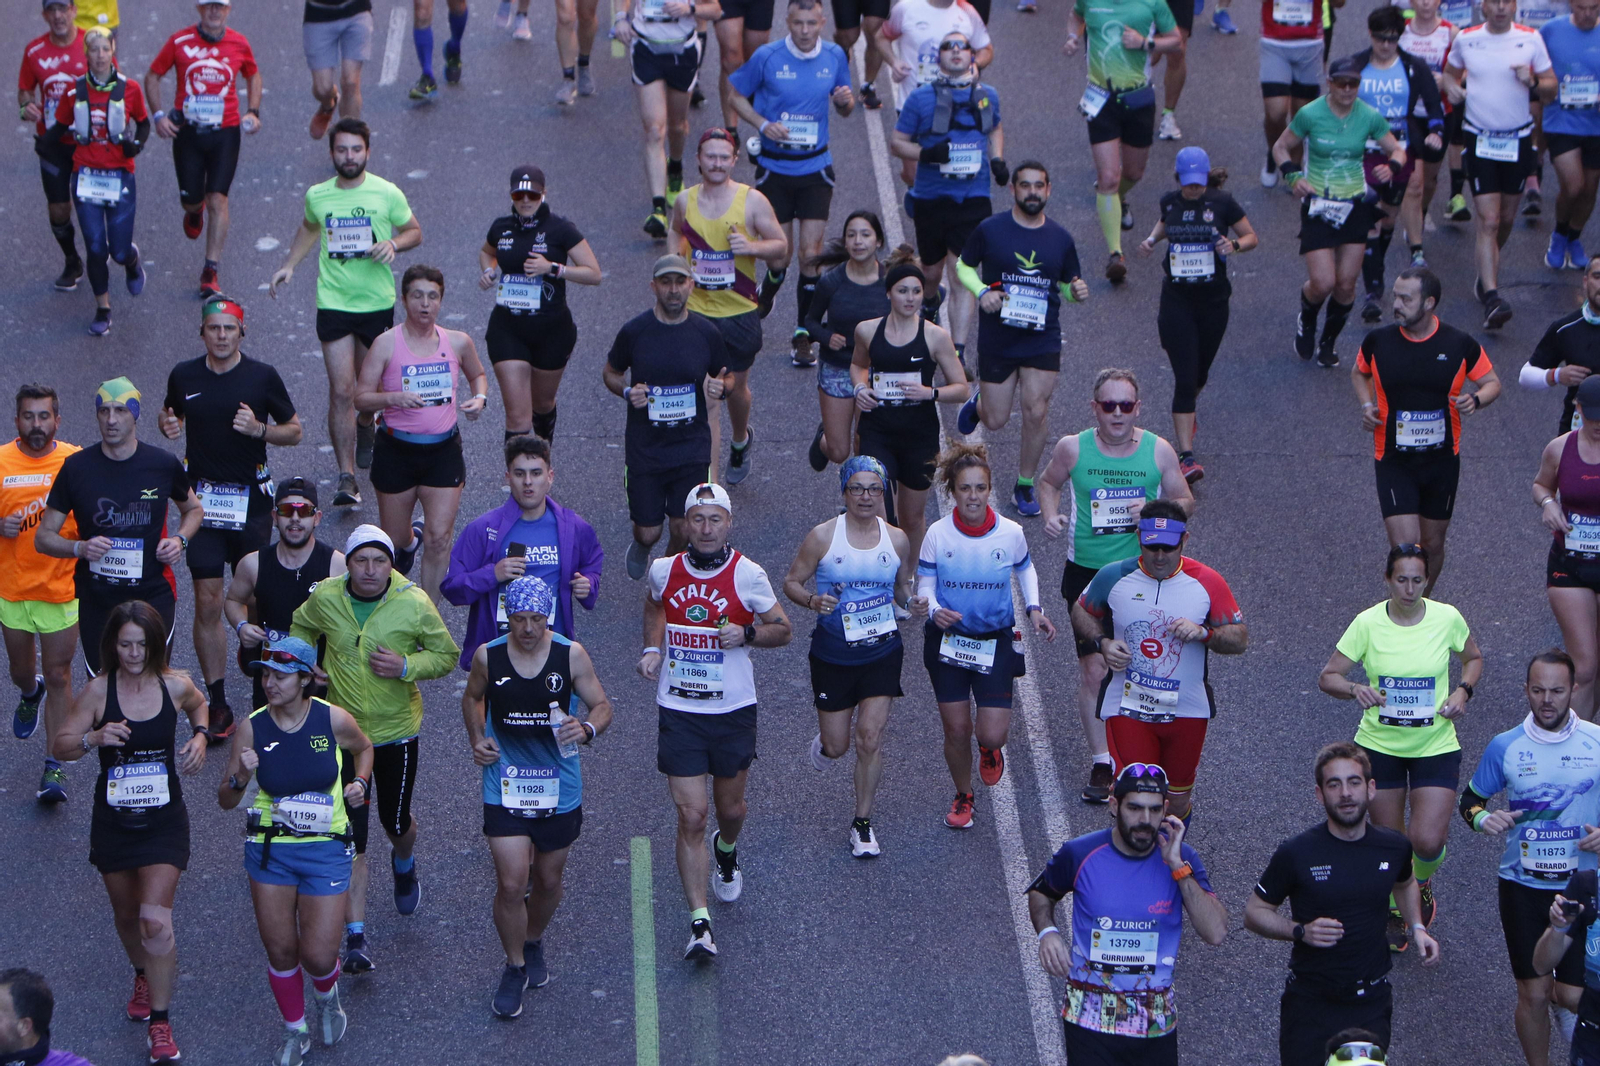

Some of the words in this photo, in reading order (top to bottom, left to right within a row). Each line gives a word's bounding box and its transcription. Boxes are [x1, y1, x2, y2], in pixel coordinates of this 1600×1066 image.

[1363, 78, 1403, 93] TIME
[1374, 94, 1393, 106] TO
[1002, 272, 1051, 285] Extremadura
[1020, 288, 1045, 298] ZURICH
[418, 365, 445, 374] ZURICH
[416, 379, 440, 388] 13059
[664, 387, 690, 395] ZURICH
[1088, 468, 1146, 478] STUBBINGTON
[4, 475, 42, 484] #BEACTIVE
[1109, 489, 1139, 498] ZURICH
[209, 499, 234, 508] 12483
[203, 511, 235, 520] BERNARDO
[104, 556, 126, 566] 9780
[959, 582, 1005, 590] VEREITAS
[669, 583, 729, 612] ITALIA
[858, 596, 886, 610] ZURICH
[858, 613, 882, 625] 13867
[668, 630, 723, 650] ROBERT
[956, 639, 982, 650] 13450
[685, 652, 716, 662] ZURICH
[955, 652, 977, 661] ESTEFA
[681, 668, 708, 677] 11869
[680, 681, 708, 690] ROBERTO
[1141, 677, 1173, 689] ZURICH
[1139, 693, 1160, 704] 9724
[1393, 696, 1419, 704] 13931
[126, 766, 160, 775] ZURICH
[125, 785, 154, 794] 11229
[516, 785, 544, 794] 11928
[292, 794, 326, 804] ZURICH
[288, 810, 317, 821] 11199
[1540, 830, 1574, 839] ZURICH
[1536, 848, 1566, 856] 11873
[1114, 921, 1151, 930] ZURICH
[1109, 939, 1141, 948] 13799
[1101, 953, 1145, 963] GURRUMINO
